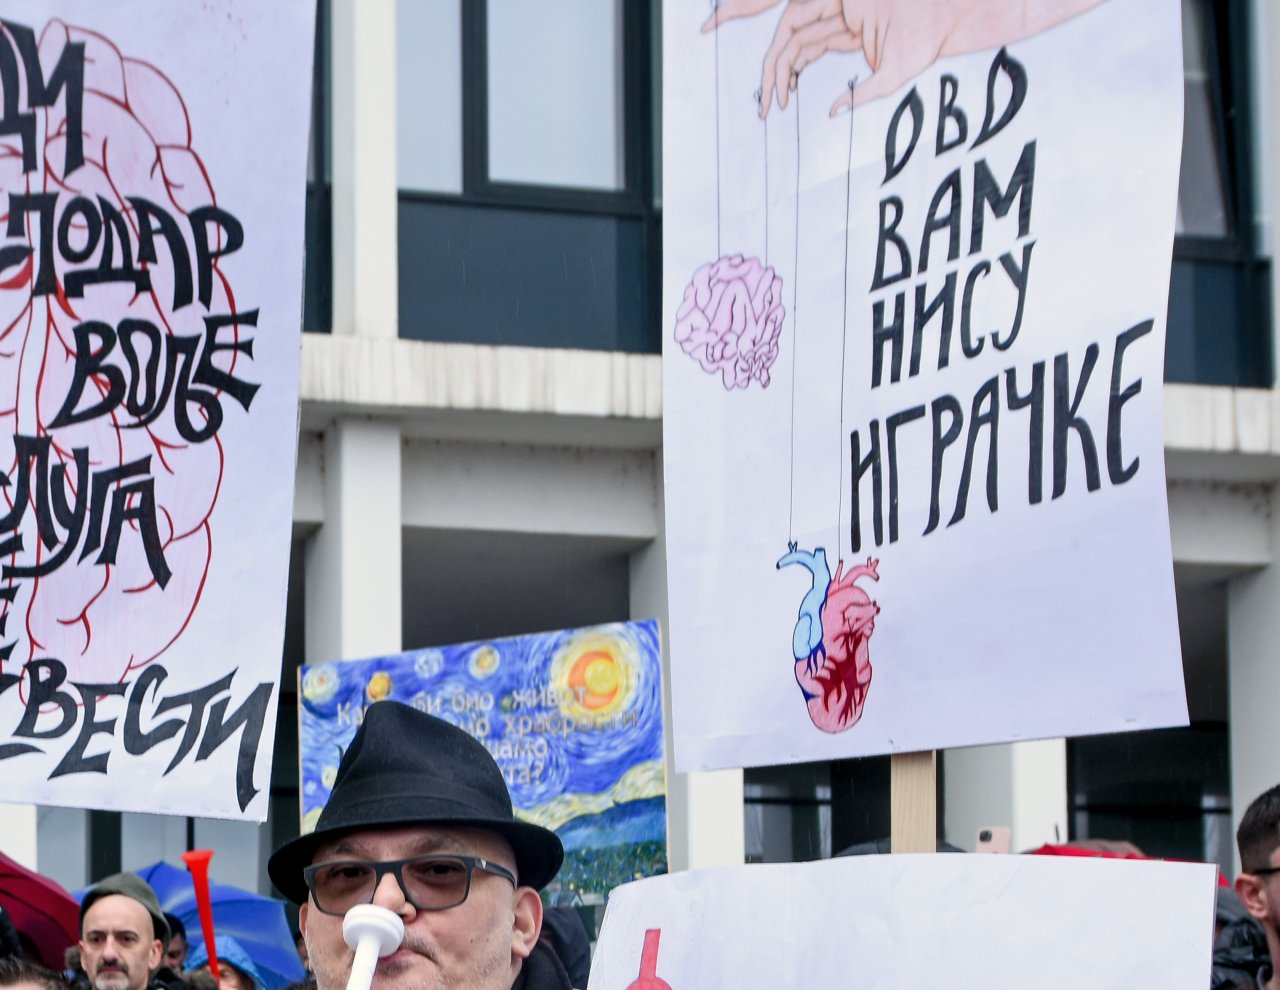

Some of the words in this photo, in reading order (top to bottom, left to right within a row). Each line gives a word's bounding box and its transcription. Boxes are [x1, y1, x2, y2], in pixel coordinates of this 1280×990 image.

[880, 46, 1028, 186] ОВО
[869, 139, 1037, 294] ВАМ
[48, 306, 261, 443] ВОЉЕ
[870, 239, 1036, 389] НИСУ
[850, 318, 1154, 554] ИГРАЧКЕ
